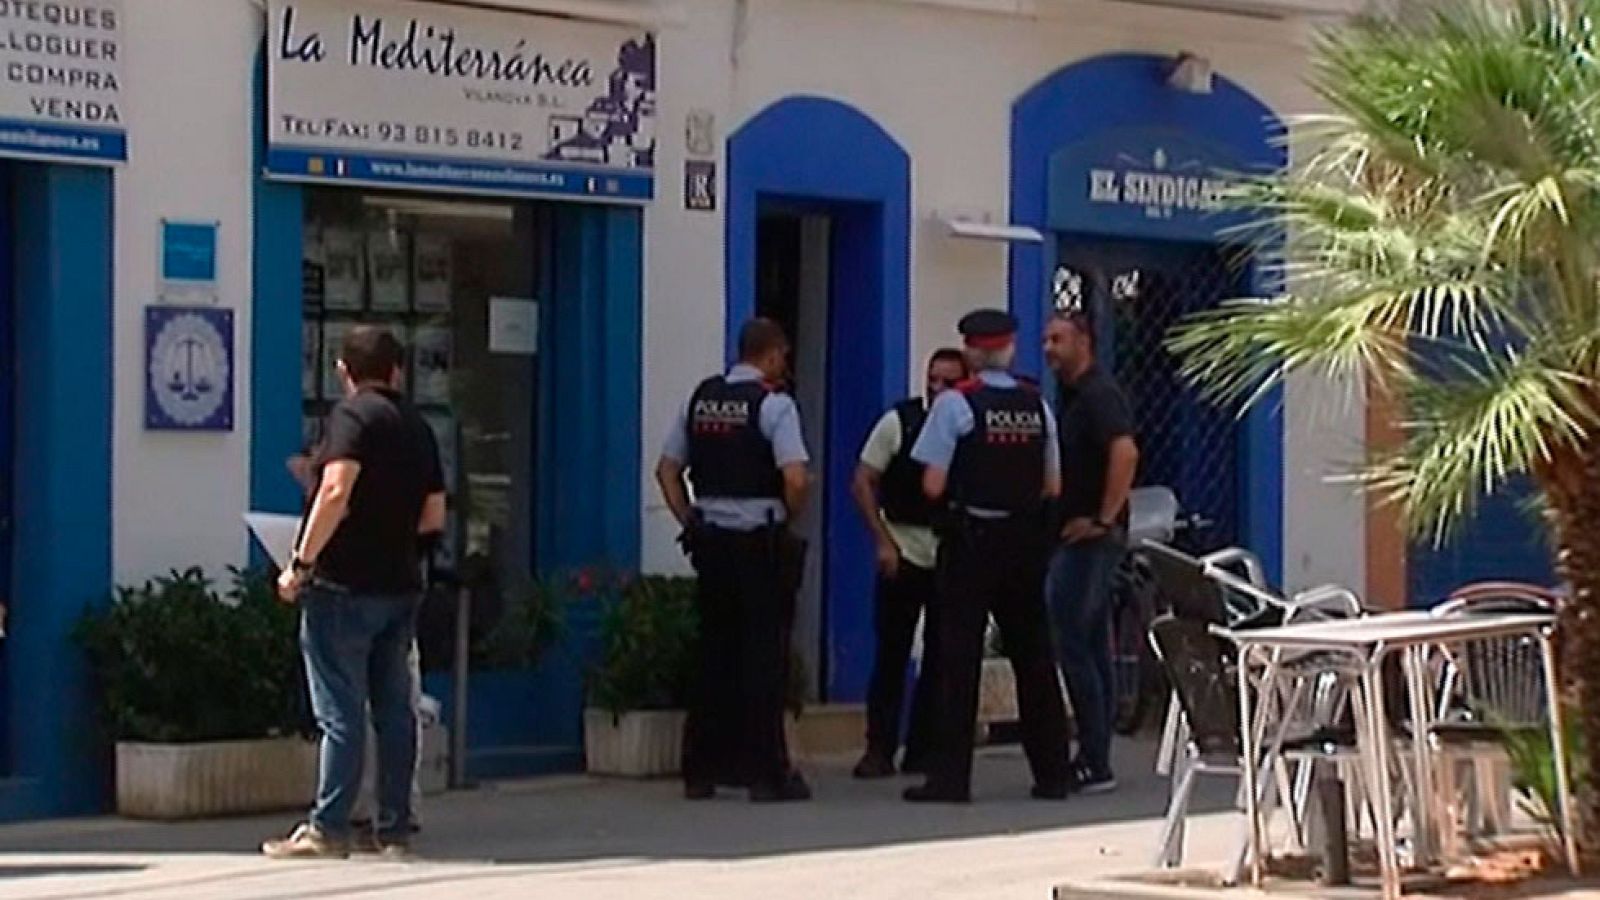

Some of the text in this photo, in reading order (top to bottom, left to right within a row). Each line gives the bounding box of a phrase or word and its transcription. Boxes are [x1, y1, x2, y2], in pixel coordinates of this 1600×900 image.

[280, 6, 594, 88] La Mediterránea
[8, 61, 119, 92] COMPRA
[29, 95, 119, 123] VENDA
[463, 87, 533, 105] VILANOVA
[378, 121, 406, 143] 93
[415, 126, 458, 147] 815
[467, 129, 523, 151] 8412
[1090, 169, 1119, 202] EL
